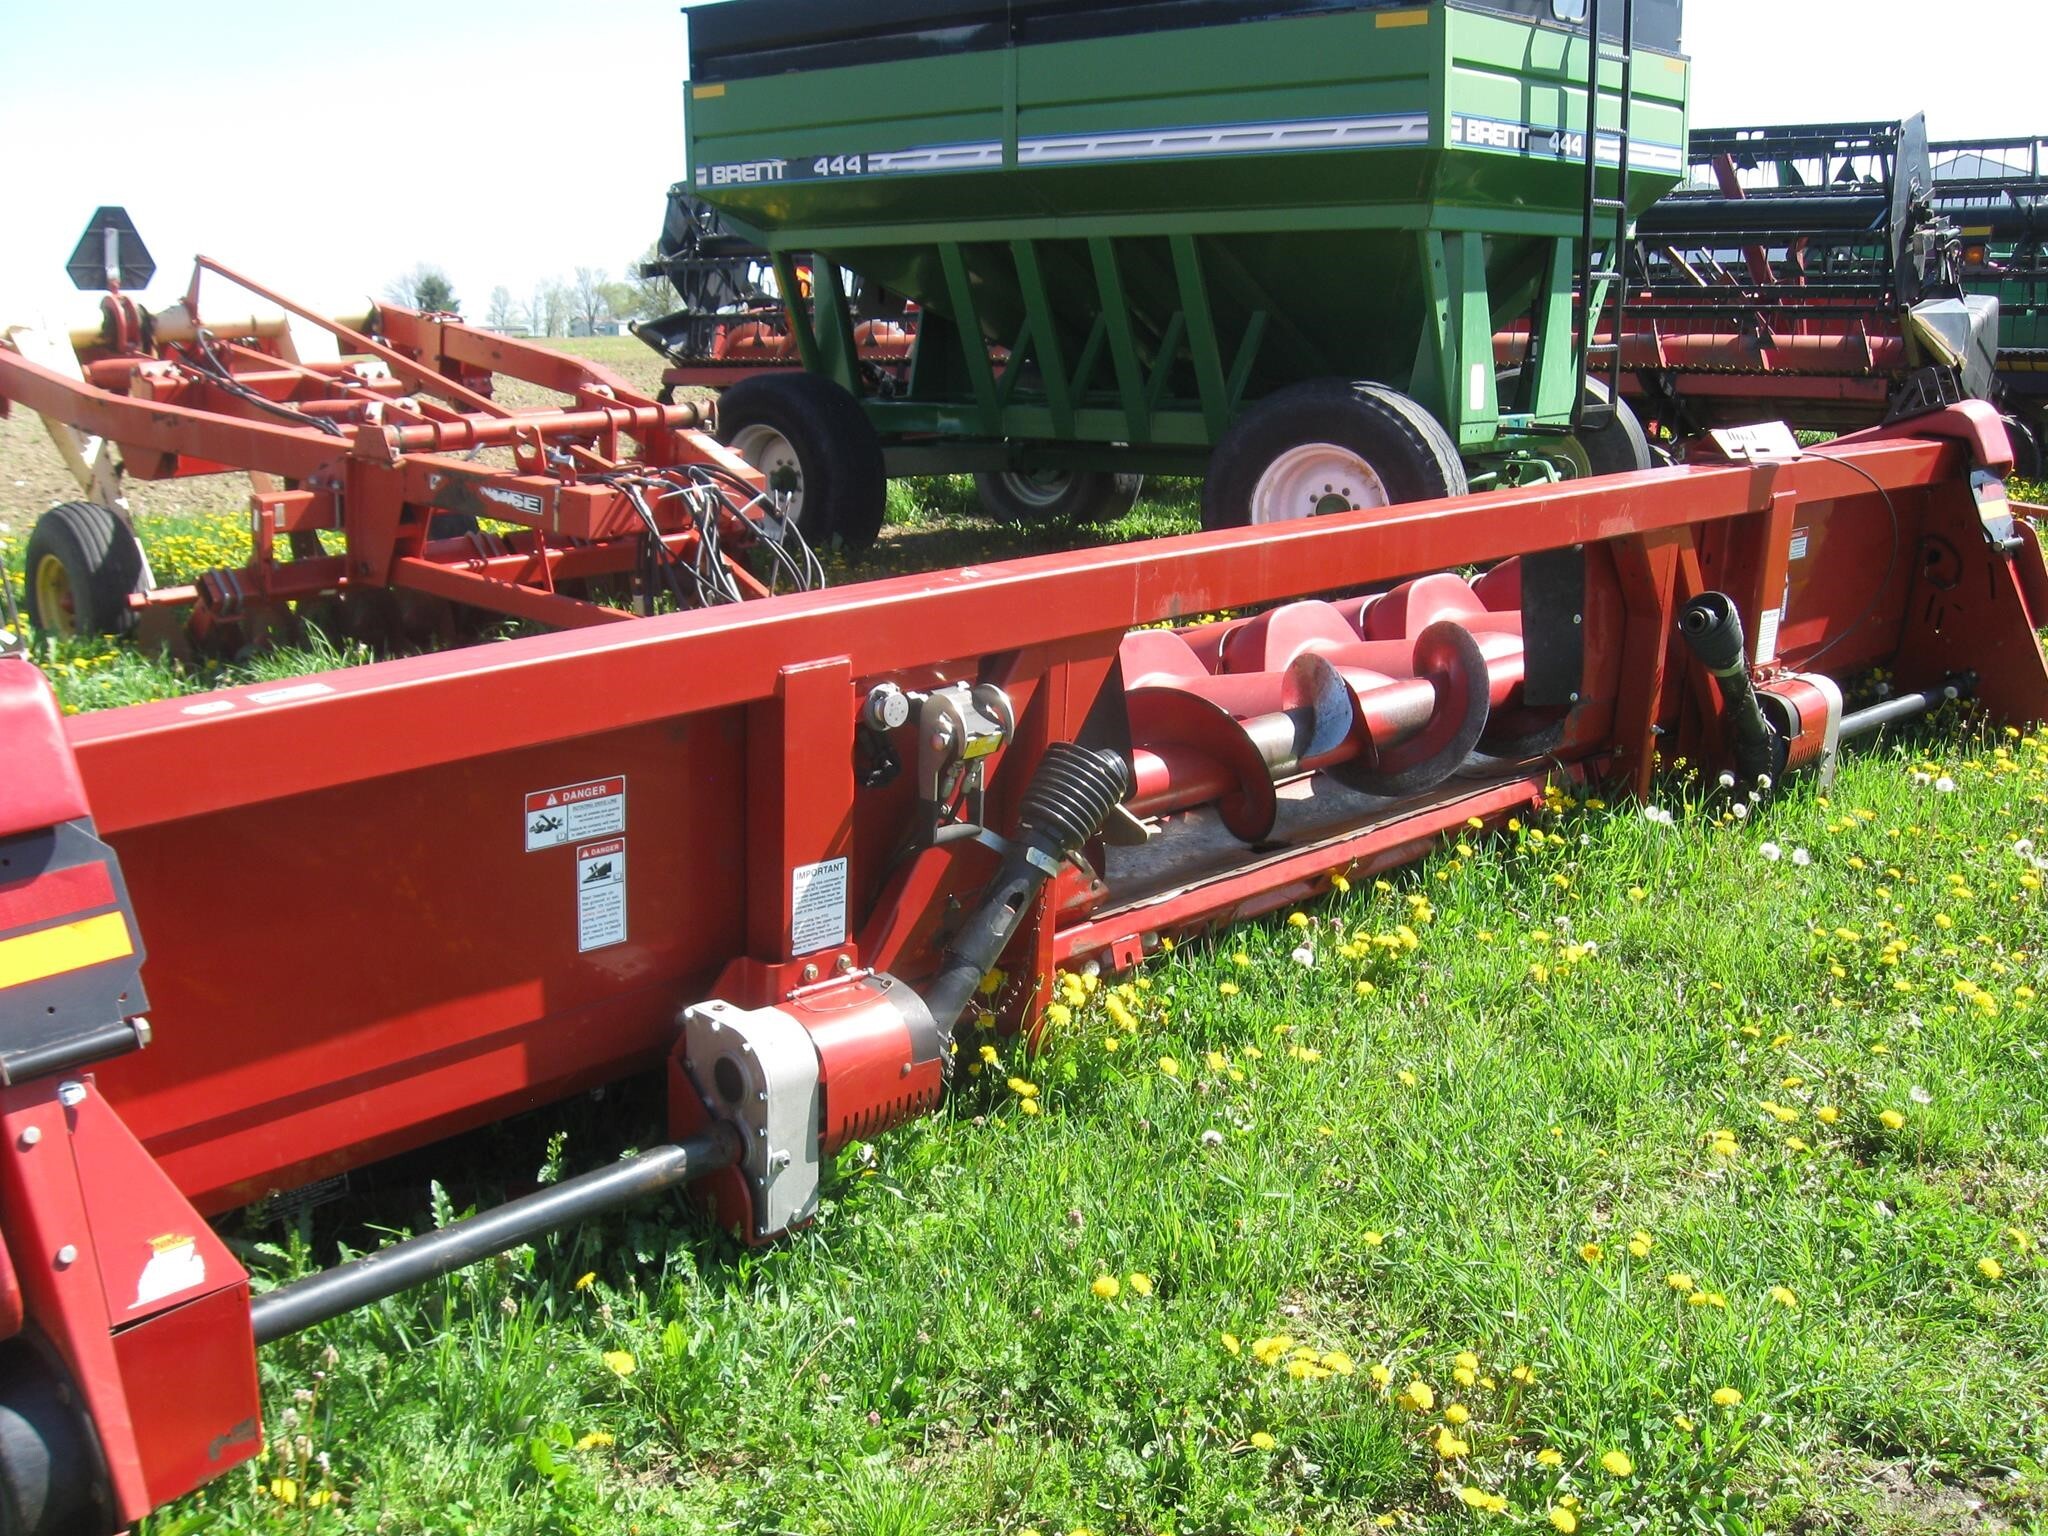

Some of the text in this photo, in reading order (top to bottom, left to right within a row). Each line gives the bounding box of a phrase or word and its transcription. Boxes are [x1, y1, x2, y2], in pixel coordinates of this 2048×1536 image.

[1466, 119, 1582, 157] BRENT 444
[711, 155, 862, 185] BRENT 444
[562, 785, 606, 802] DANGER
[590, 844, 620, 856] DANGER
[796, 861, 845, 880] IMPORTANT
